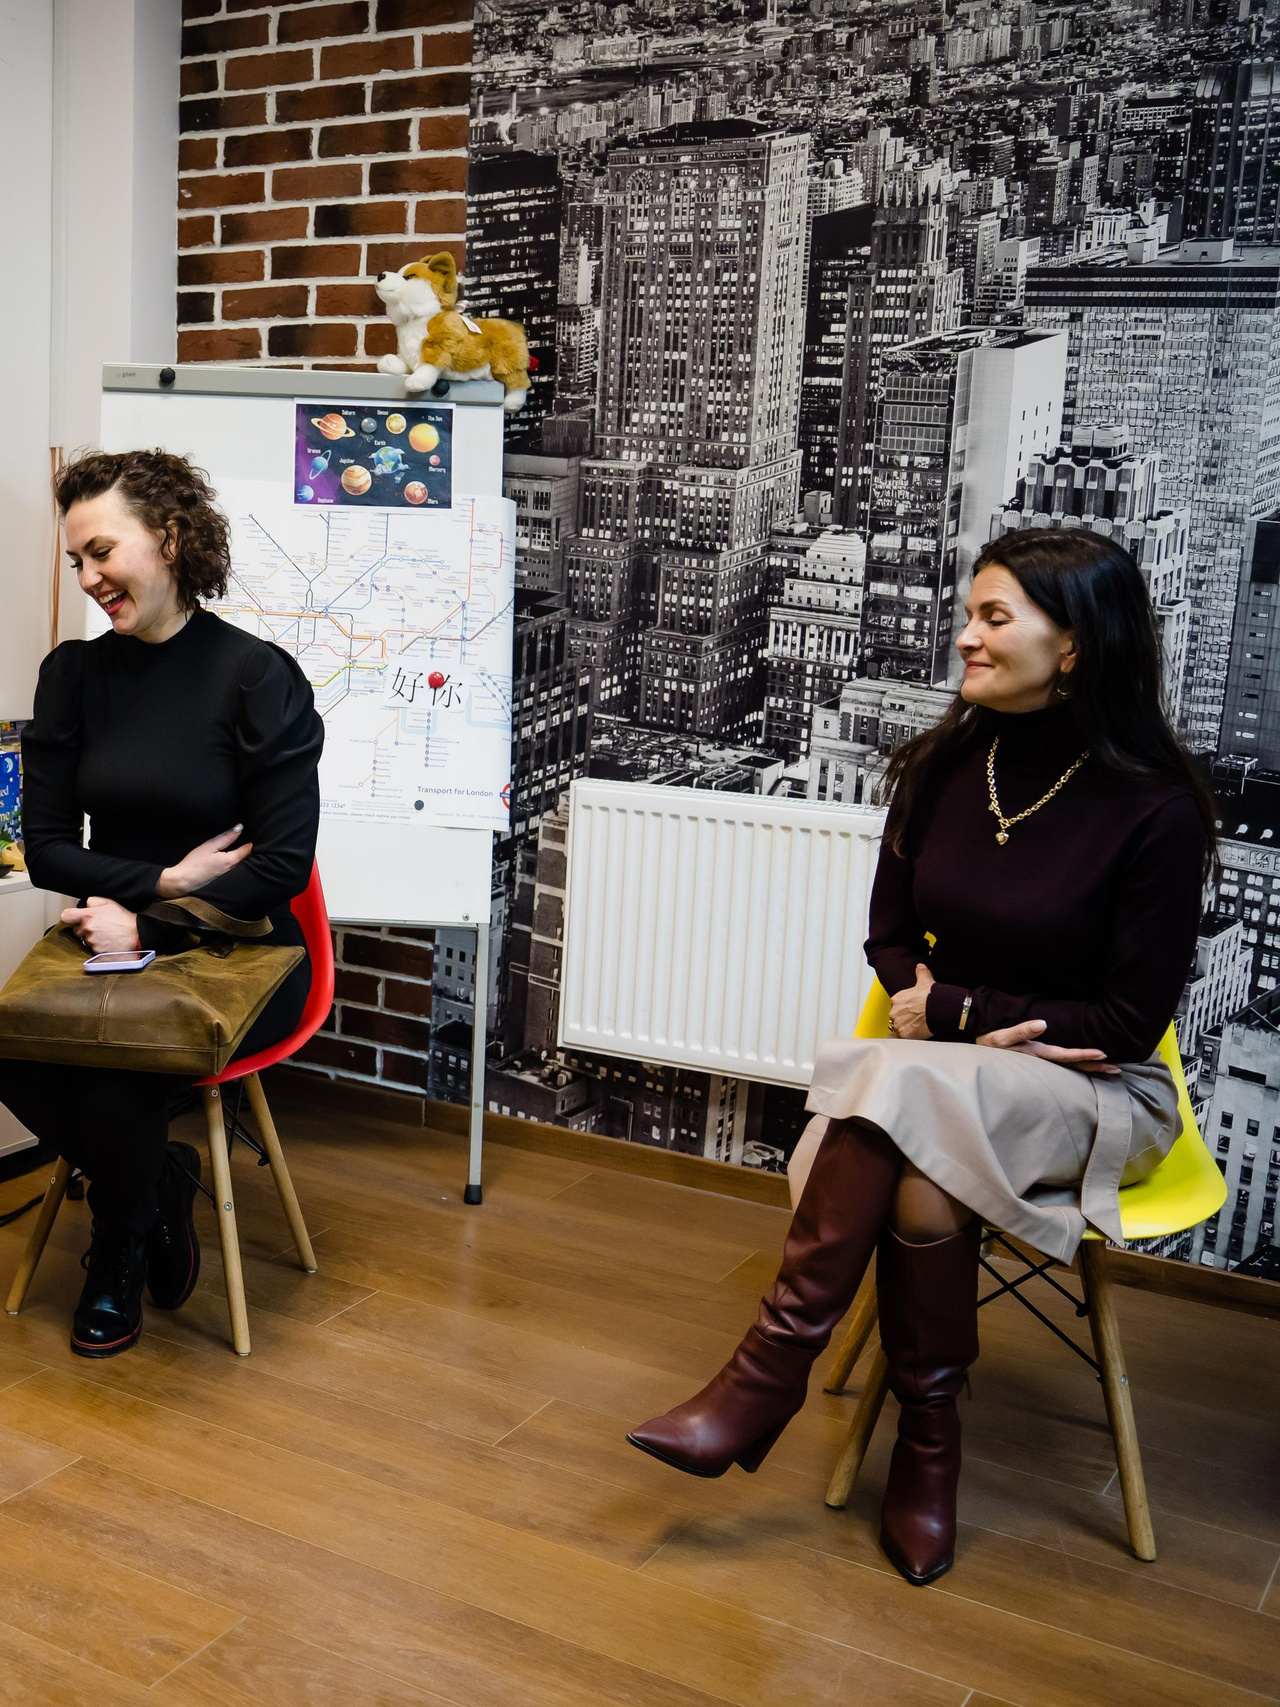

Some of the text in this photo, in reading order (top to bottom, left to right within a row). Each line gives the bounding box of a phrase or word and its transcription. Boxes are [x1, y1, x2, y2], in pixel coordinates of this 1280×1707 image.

[417, 785, 453, 795] Transport
[454, 787, 465, 795] for
[466, 789, 494, 797] London
